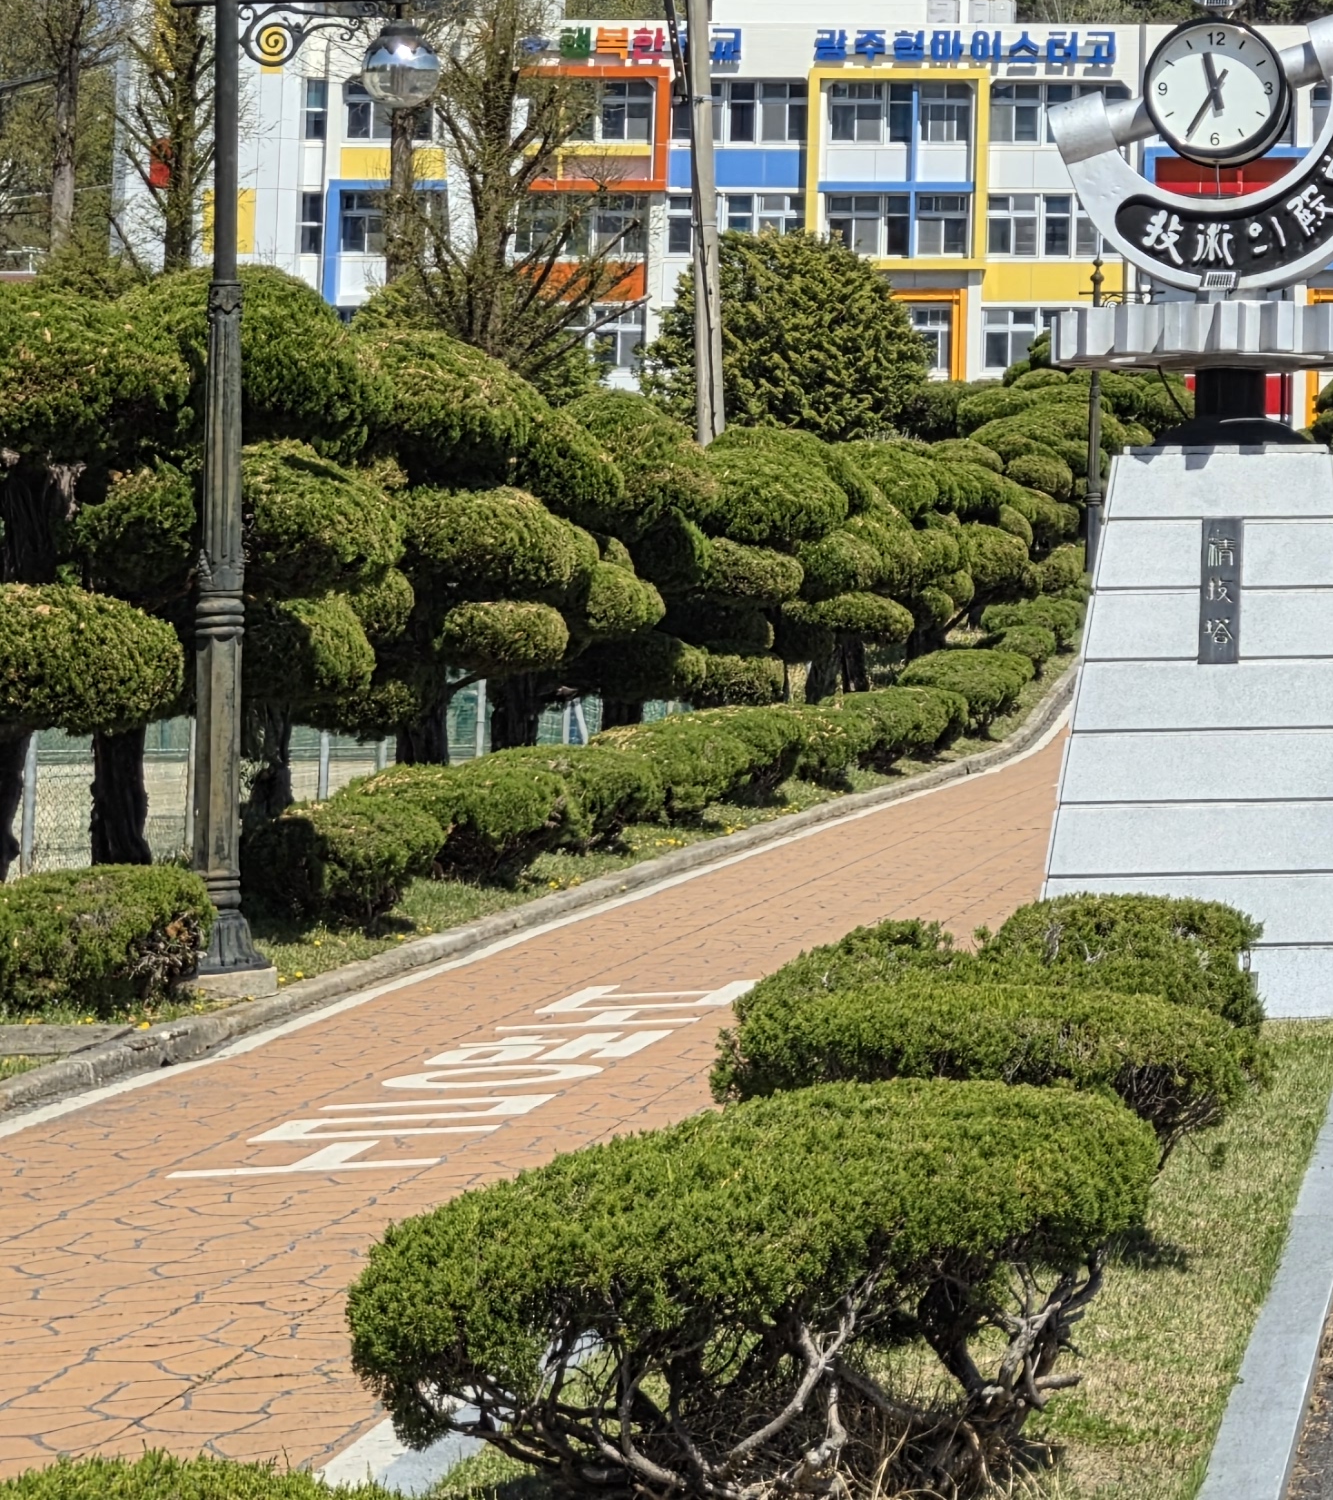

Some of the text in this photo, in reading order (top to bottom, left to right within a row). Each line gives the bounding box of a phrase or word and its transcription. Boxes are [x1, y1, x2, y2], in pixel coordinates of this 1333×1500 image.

[559, 26, 742, 60] 행복한교
[1207, 32, 1226, 46] 12
[1158, 82, 1168, 96] 9
[1263, 81, 1274, 96] 3
[1210, 132, 1220, 146] 6
